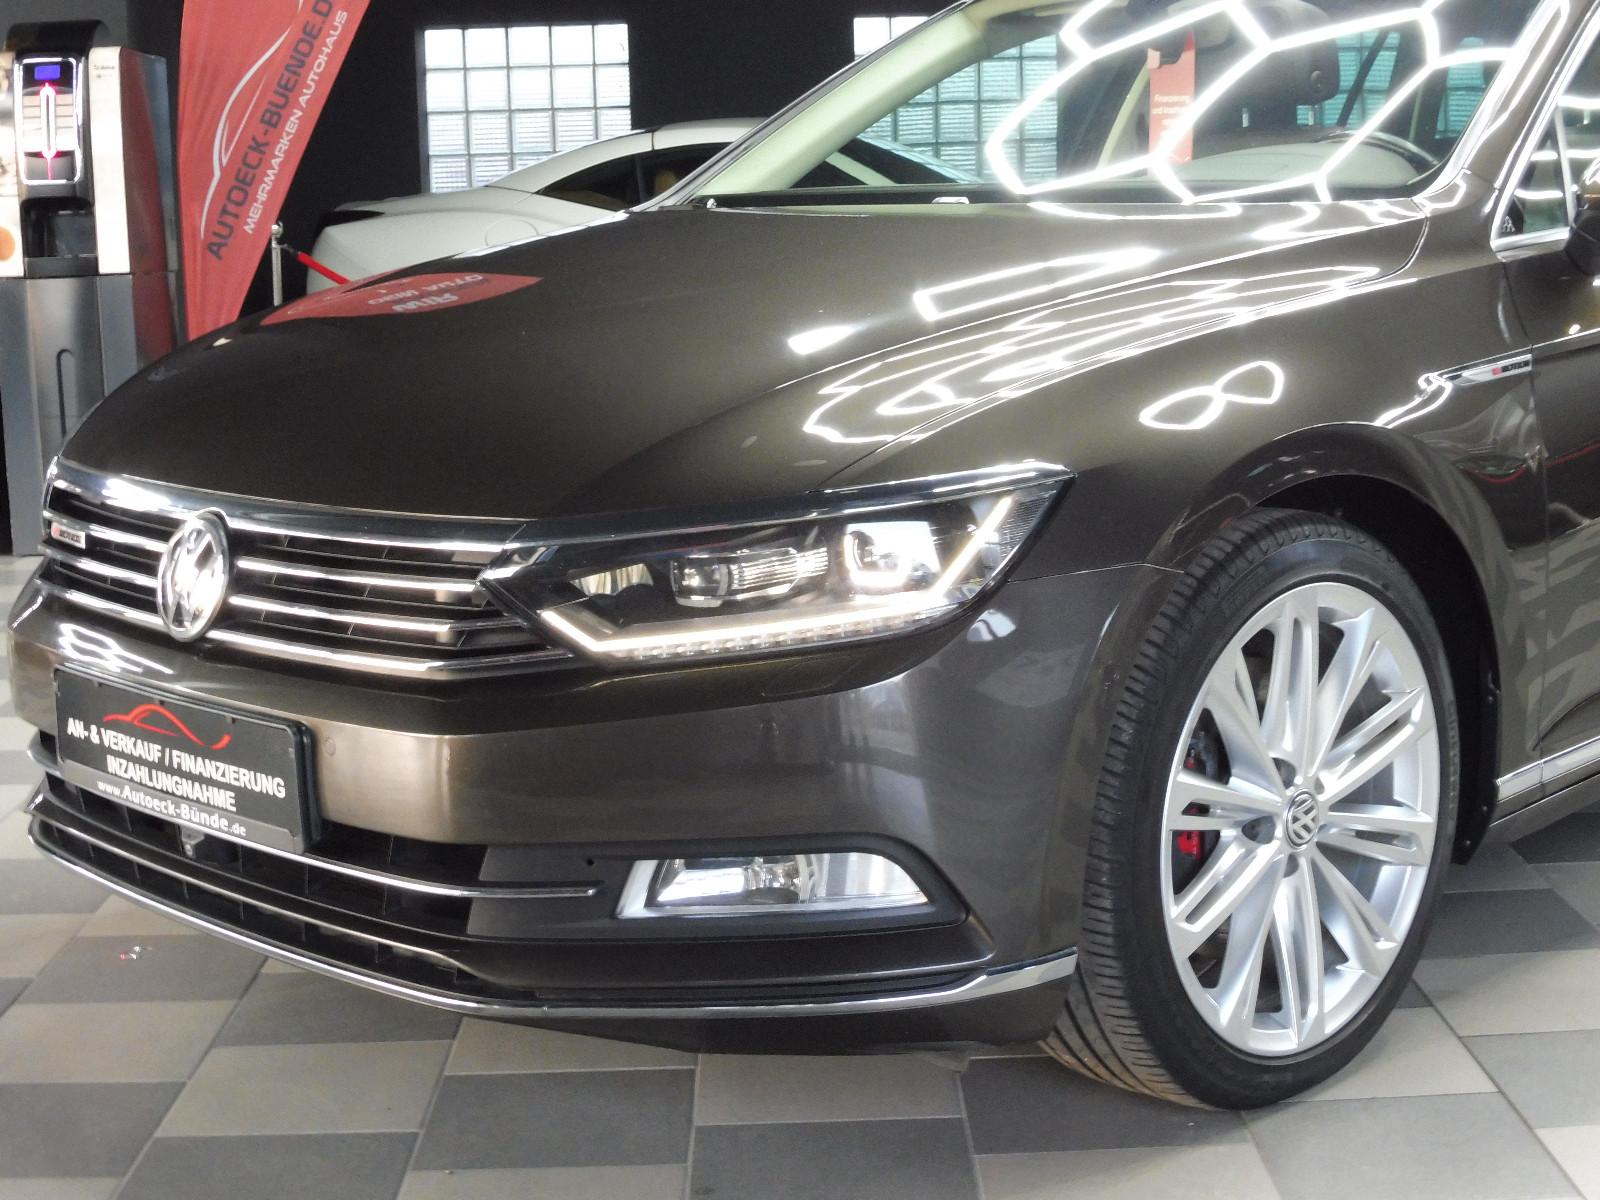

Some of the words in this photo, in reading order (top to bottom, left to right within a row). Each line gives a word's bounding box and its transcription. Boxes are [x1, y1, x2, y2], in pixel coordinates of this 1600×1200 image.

[243, 108, 304, 235] MEHRMARKEN
[298, 10, 348, 109] AUTOHAUS
[89, 724, 100, 745] &
[100, 727, 162, 764] VERKAUF
[171, 749, 286, 799] FINANZIERUNG
[106, 754, 237, 812] INZAHLUNGNAHME
[96, 780, 247, 837] www.Autoeck-Bünde.de
